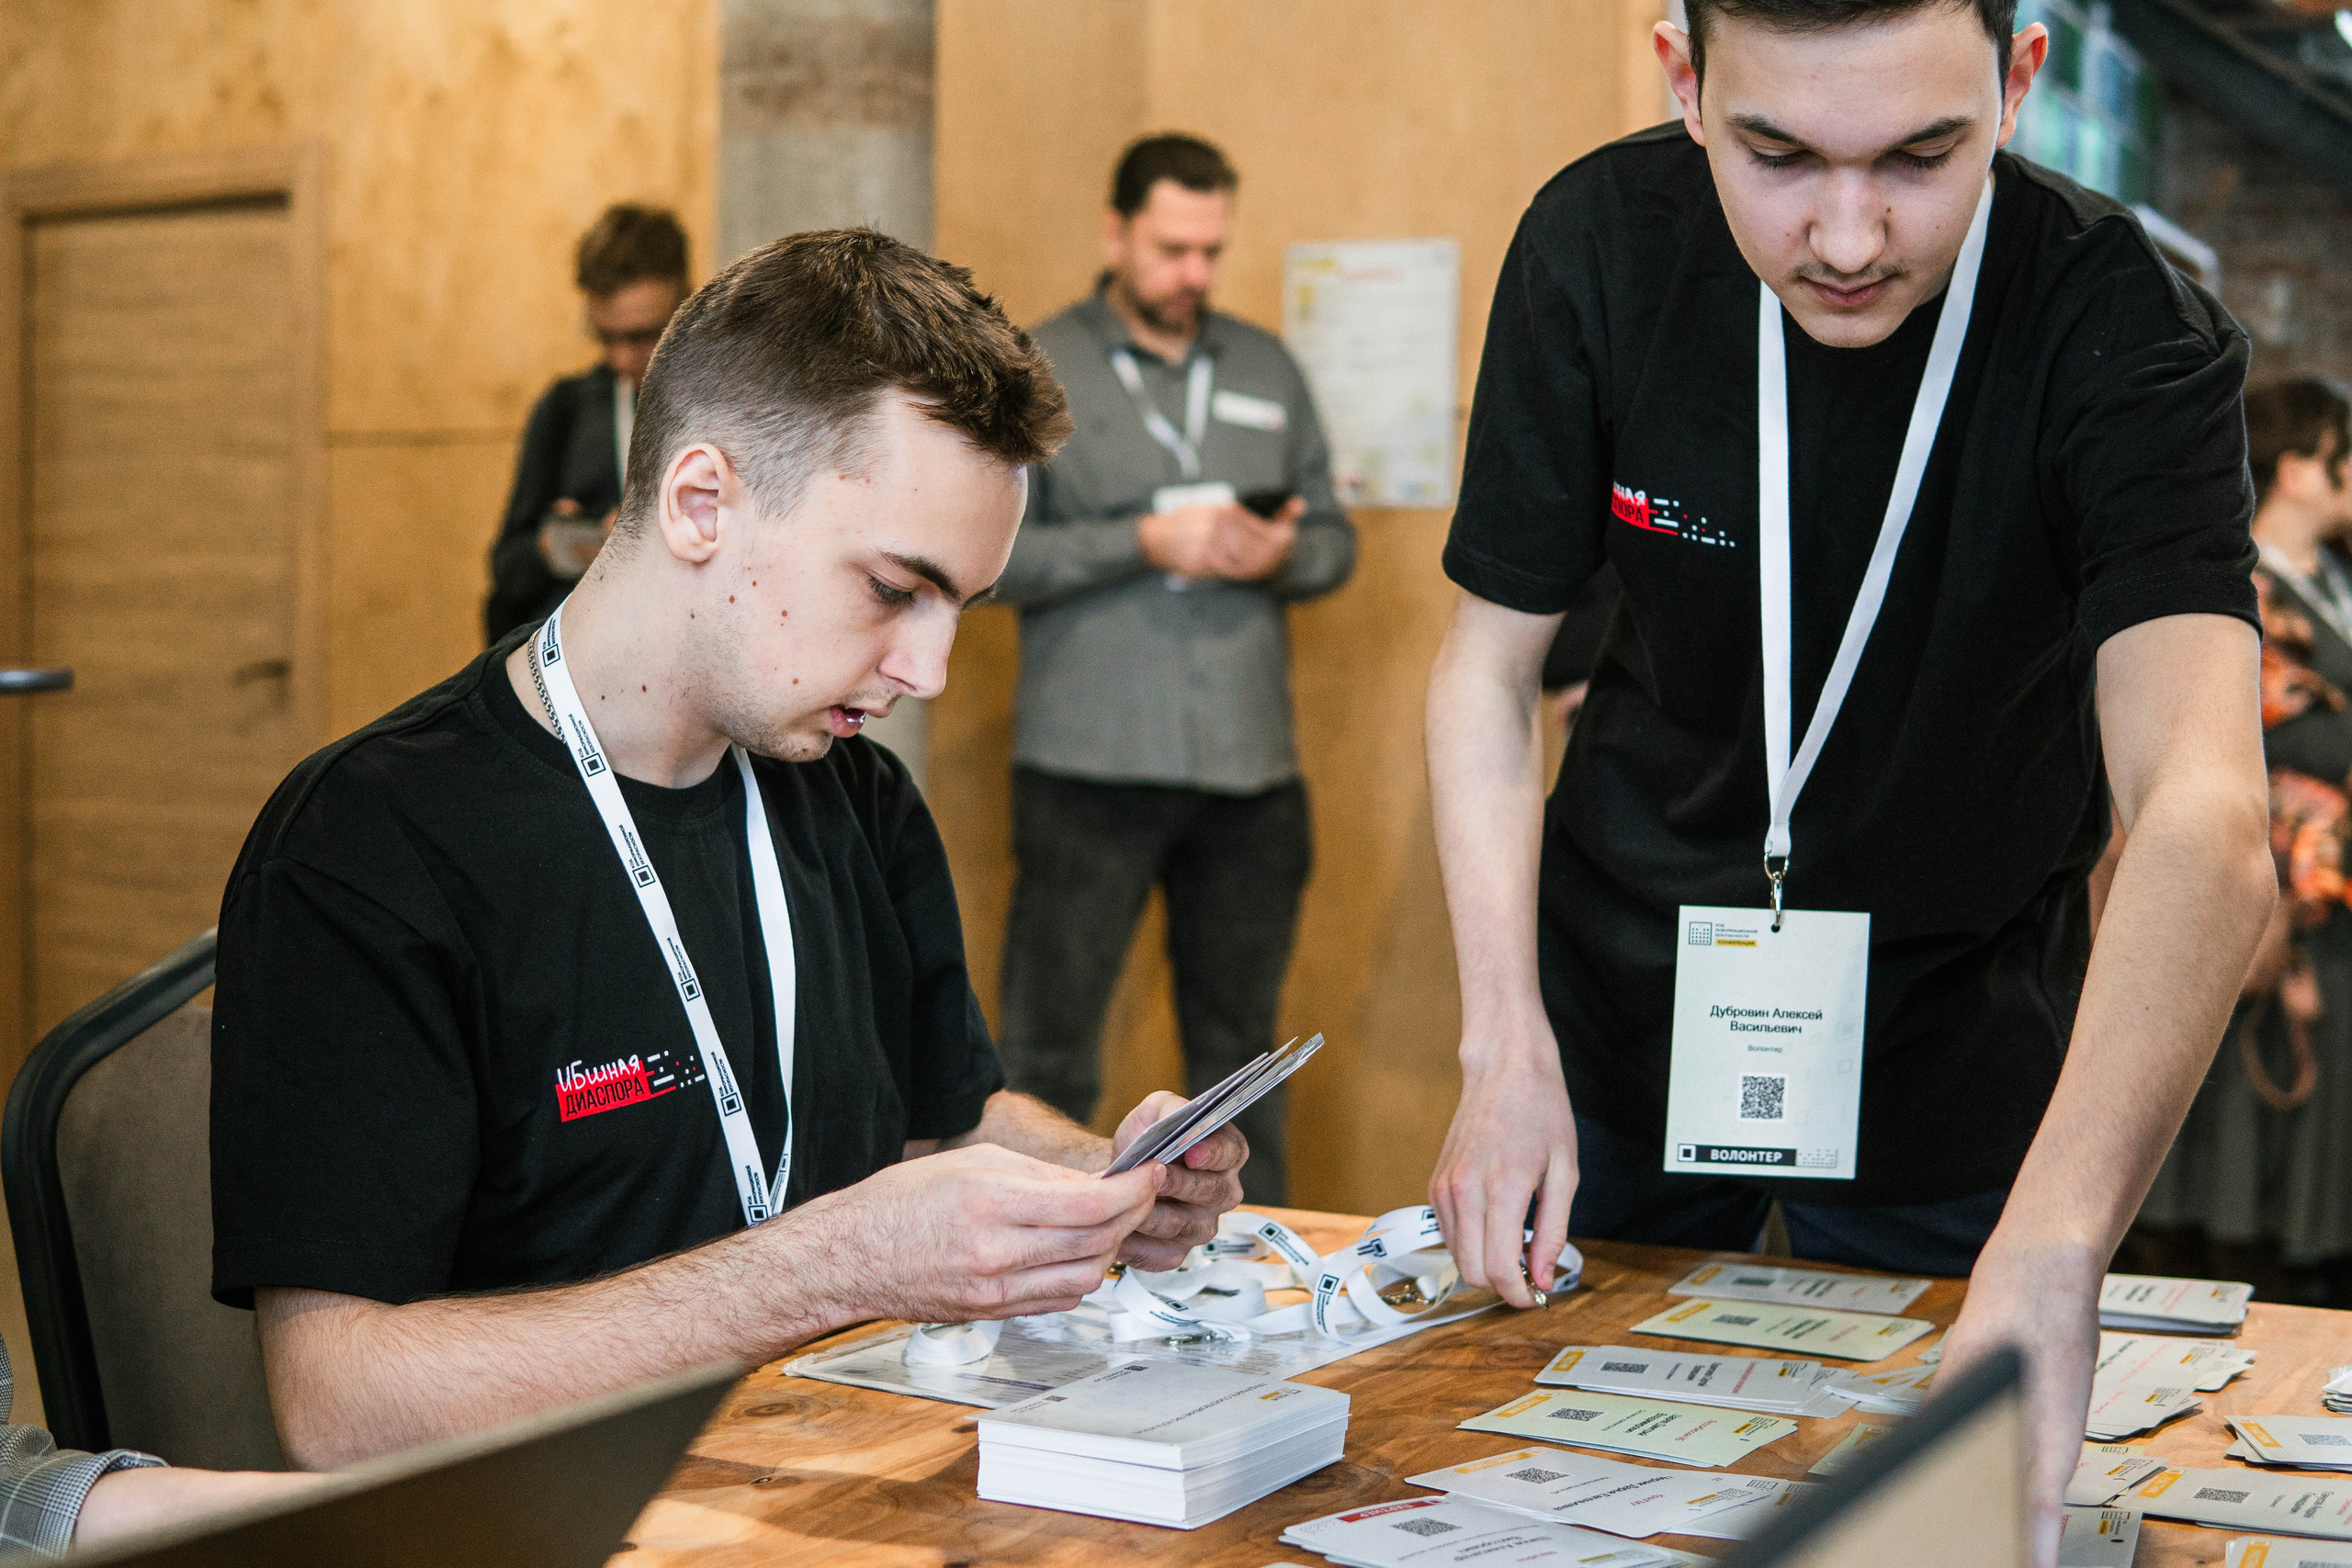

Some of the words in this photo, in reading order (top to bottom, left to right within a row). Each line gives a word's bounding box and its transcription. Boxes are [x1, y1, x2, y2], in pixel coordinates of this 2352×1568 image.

[1709, 1005, 1770, 1019] Дубровин
[1771, 1008, 1823, 1021] Алексей
[1729, 1021, 1803, 1034] Васильевич
[1747, 1043, 1783, 1054] Волонтер
[565, 1076, 645, 1118] ДИАСПОРА
[1710, 1148, 1783, 1164] ВОЛОНТЕР
